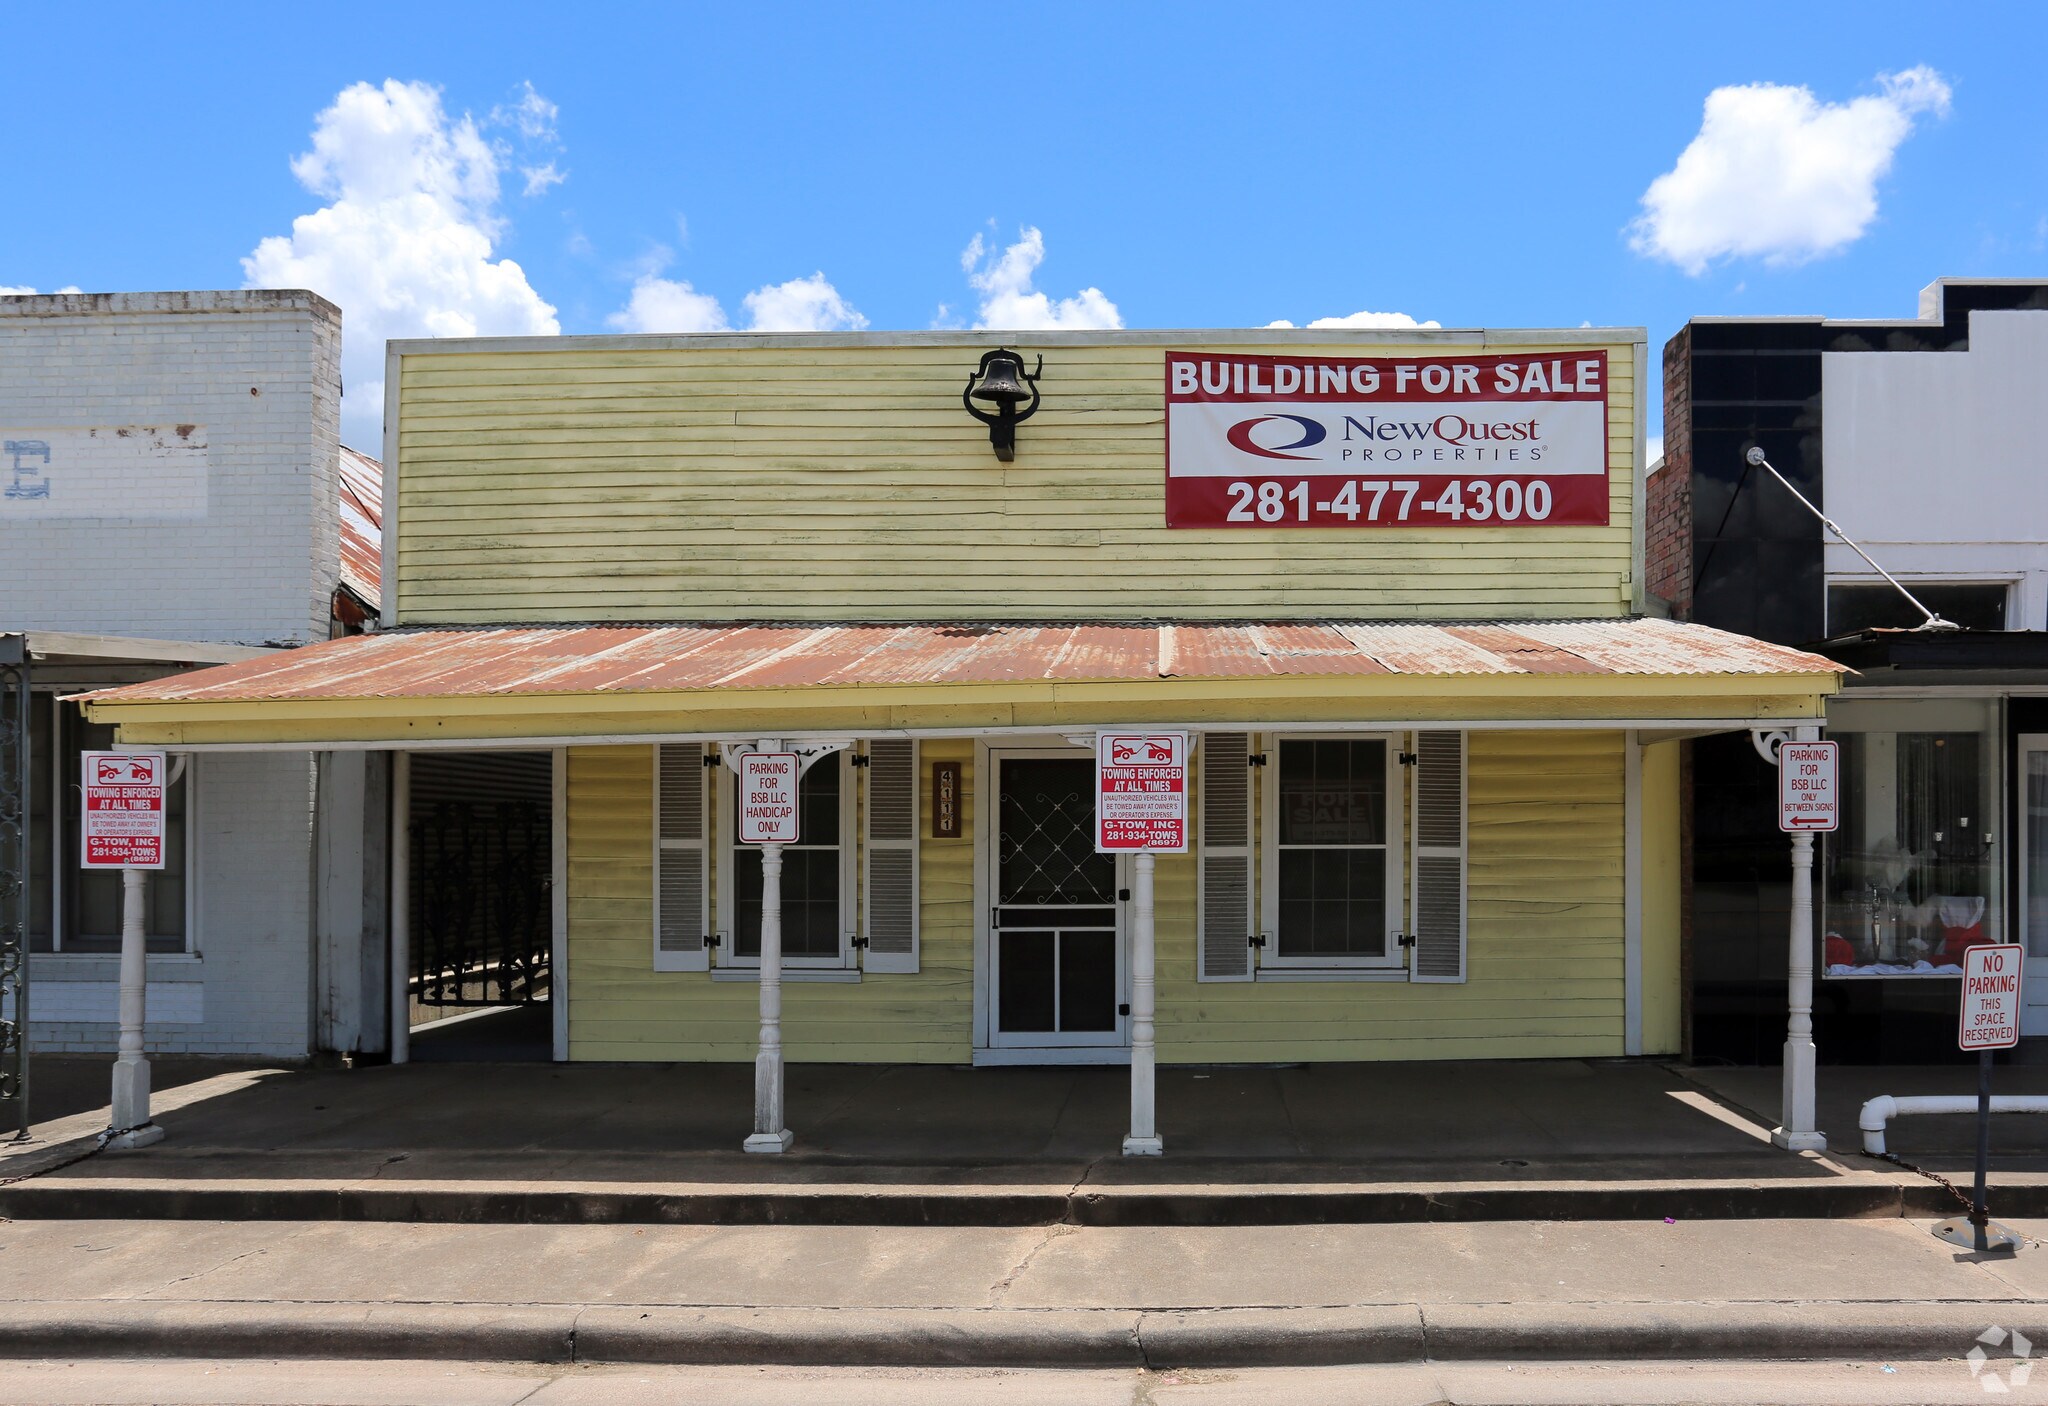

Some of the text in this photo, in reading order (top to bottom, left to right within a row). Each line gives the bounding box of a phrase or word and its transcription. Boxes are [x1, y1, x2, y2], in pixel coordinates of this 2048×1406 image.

[1171, 360, 1600, 395] BUILDING FOR SALE
[1342, 415, 1541, 446] NewQuest
[1226, 480, 1552, 521] 281-477-4300
[1790, 750, 1828, 761] PARKING
[750, 763, 788, 774] PARKING
[1102, 768, 1181, 779] TOWING ENFORCED
[1800, 765, 1818, 775] FOR
[760, 778, 777, 788] FOR
[1114, 781, 1170, 791] AT ALL TIMES
[1792, 779, 1827, 790] BSB LLC
[89, 788, 160, 798] TOWING ENFORCED
[751, 792, 787, 803] BSB LLC
[1801, 793, 1817, 801] ONLY
[100, 800, 151, 809] AT ALL TIMES
[1785, 803, 1833, 811] BETWEEN SIGNS
[746, 807, 792, 817] HANDICAP
[1293, 807, 1366, 822] SALE
[758, 822, 780, 832] ONLY
[1104, 821, 1149, 830] G-TOW,
[1107, 831, 1177, 840] 281-934-TOWS
[90, 838, 131, 847] G-TOW,
[92, 848, 156, 856] 281-934-TOWS
[1983, 955, 2003, 972] NO
[1969, 975, 2015, 994] PARKING
[1981, 998, 2001, 1010] THIS
[1975, 1012, 2005, 1025] SPACE
[1965, 1027, 2013, 1041] RESERVED
